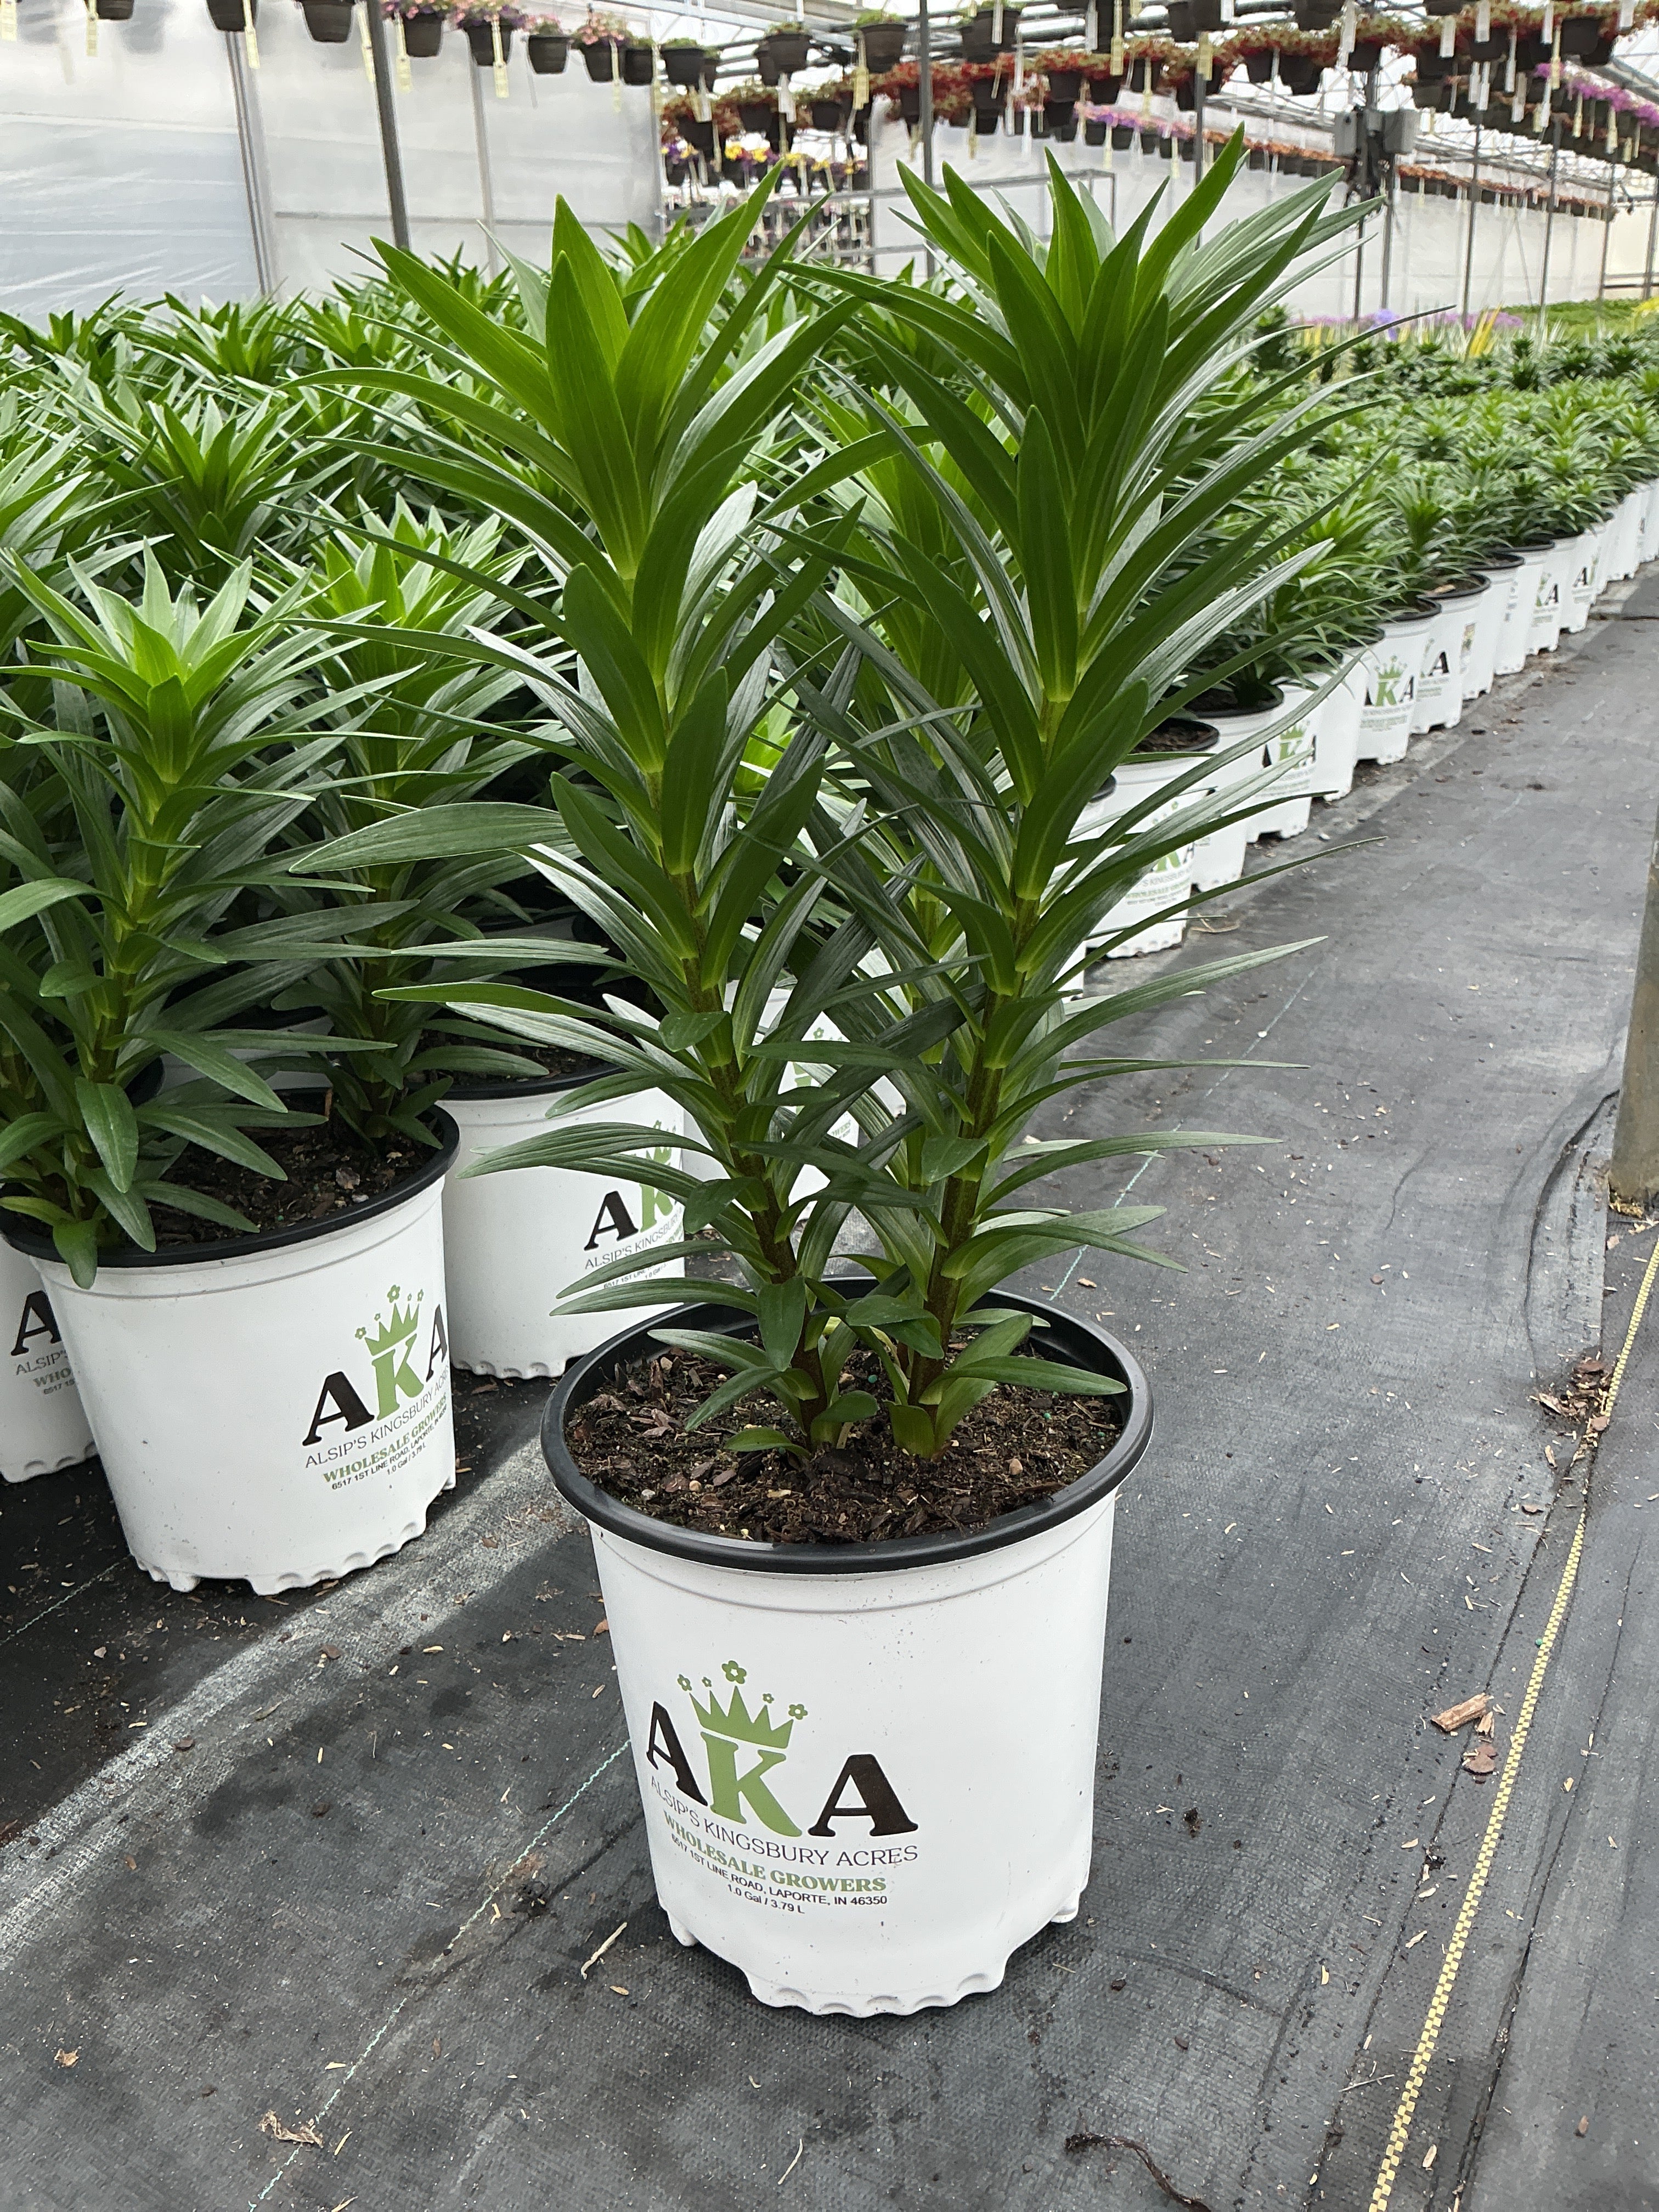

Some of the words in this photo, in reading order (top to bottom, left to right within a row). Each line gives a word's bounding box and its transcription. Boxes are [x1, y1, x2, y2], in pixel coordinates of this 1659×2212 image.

[584, 1183, 678, 1251] AK
[585, 1245, 632, 1269] ALSIP'S
[635, 1214, 678, 1252] KINGSBURY
[302, 1304, 448, 1447] AKA
[306, 1436, 366, 1468] ALSIP'S
[371, 1387, 433, 1443] KINGSBURY
[323, 1432, 410, 1482] WHOLESALE
[411, 1392, 446, 1438] GROWERS
[332, 1477, 352, 1489] 6517
[354, 1470, 369, 1481] 1ST
[371, 1460, 388, 1474] LINE
[387, 1465, 396, 1475] 1.0
[398, 1457, 408, 1468] Gal
[646, 1701, 918, 1837] AKA
[651, 1776, 700, 1827] ALSIP'S
[703, 1818, 829, 1866] KINGSBURY
[836, 1846, 918, 1866] ACRES
[663, 1809, 766, 1880] WHOLESALE
[770, 1870, 887, 1892] GROWERS
[672, 1833, 688, 1852] 6517
[690, 1850, 705, 1865] 1ST
[707, 1860, 729, 1880] LINE
[731, 1874, 766, 1894] ROAD,
[769, 1887, 831, 1905] LAPORTE,
[834, 1897, 847, 1905] IN
[850, 1896, 887, 1905] 46350
[727, 1884, 742, 1896] 1.0
[744, 1891, 762, 1904] Gal
[771, 1899, 794, 1911] 3.79
[798, 1905, 805, 1914] L
